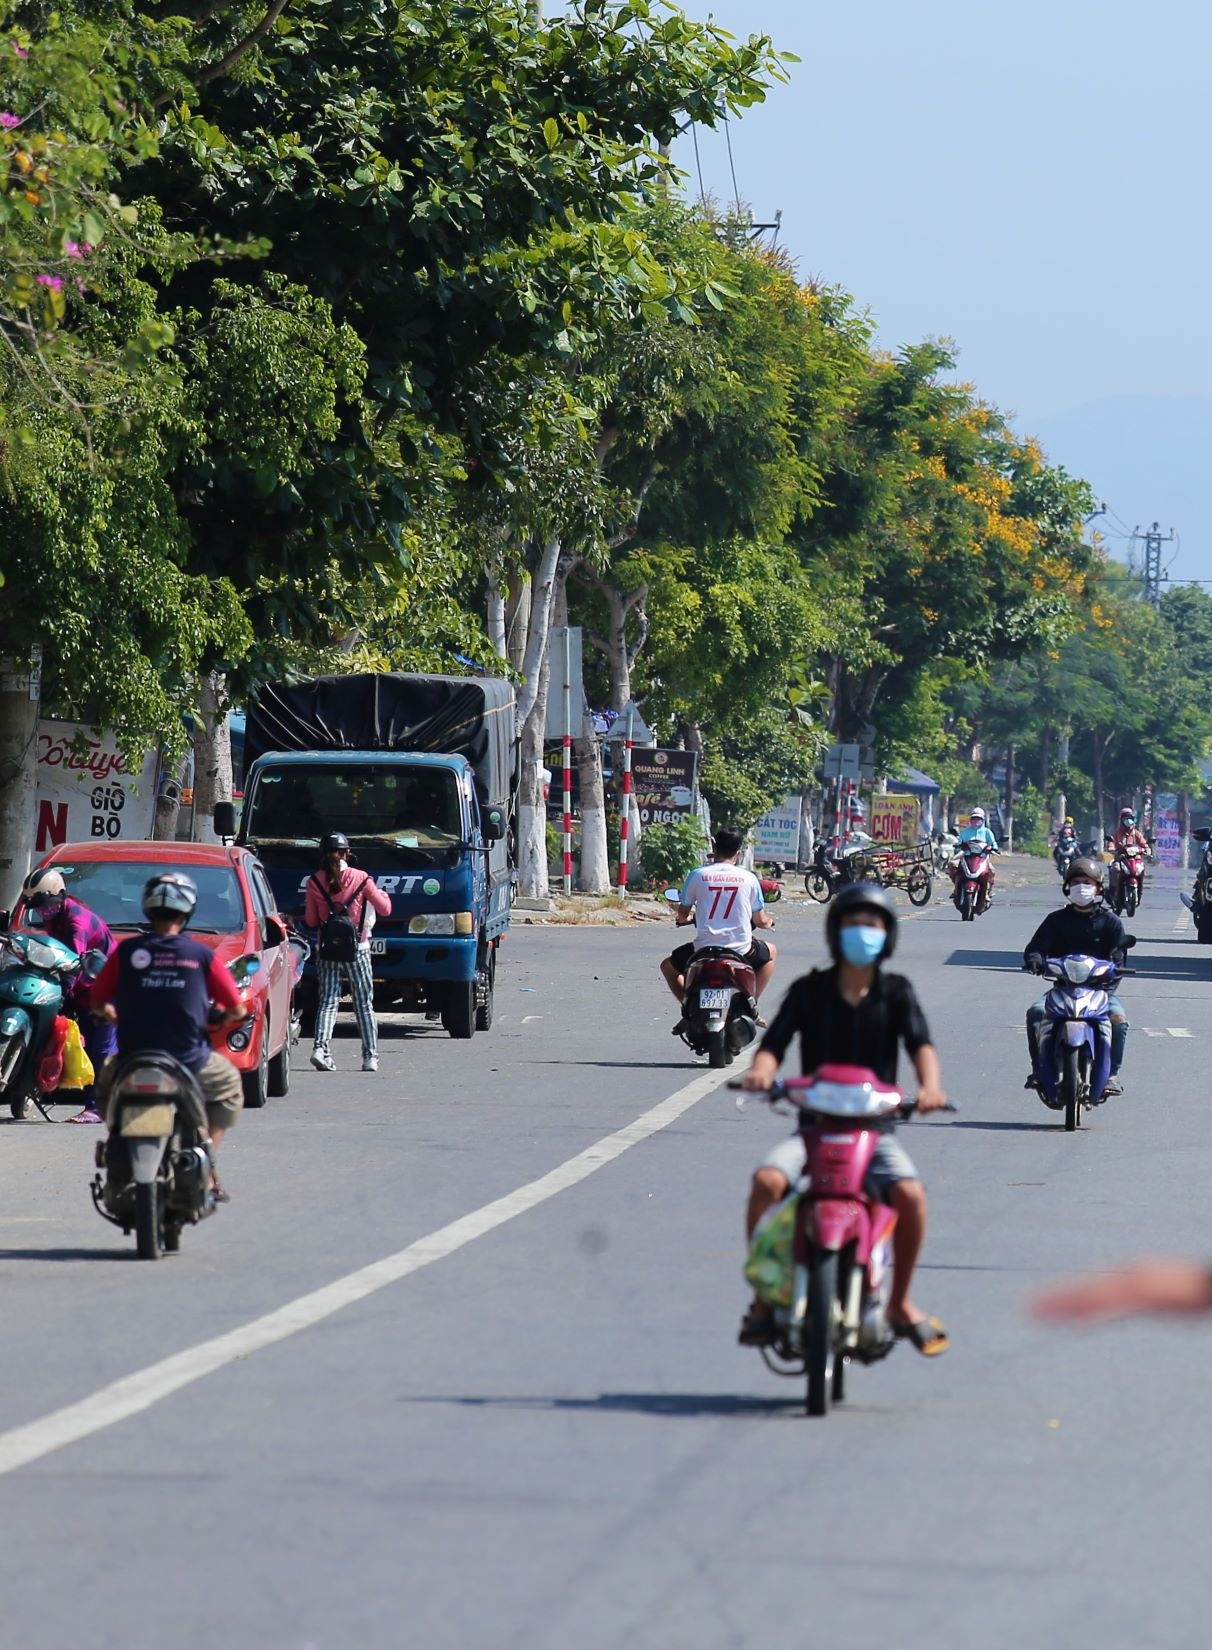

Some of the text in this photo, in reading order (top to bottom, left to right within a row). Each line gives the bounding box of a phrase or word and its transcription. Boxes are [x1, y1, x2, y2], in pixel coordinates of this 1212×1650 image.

[635, 765, 685, 776] QUANG LINH
[872, 812, 902, 840] CƠM
[708, 886, 739, 920] 77
